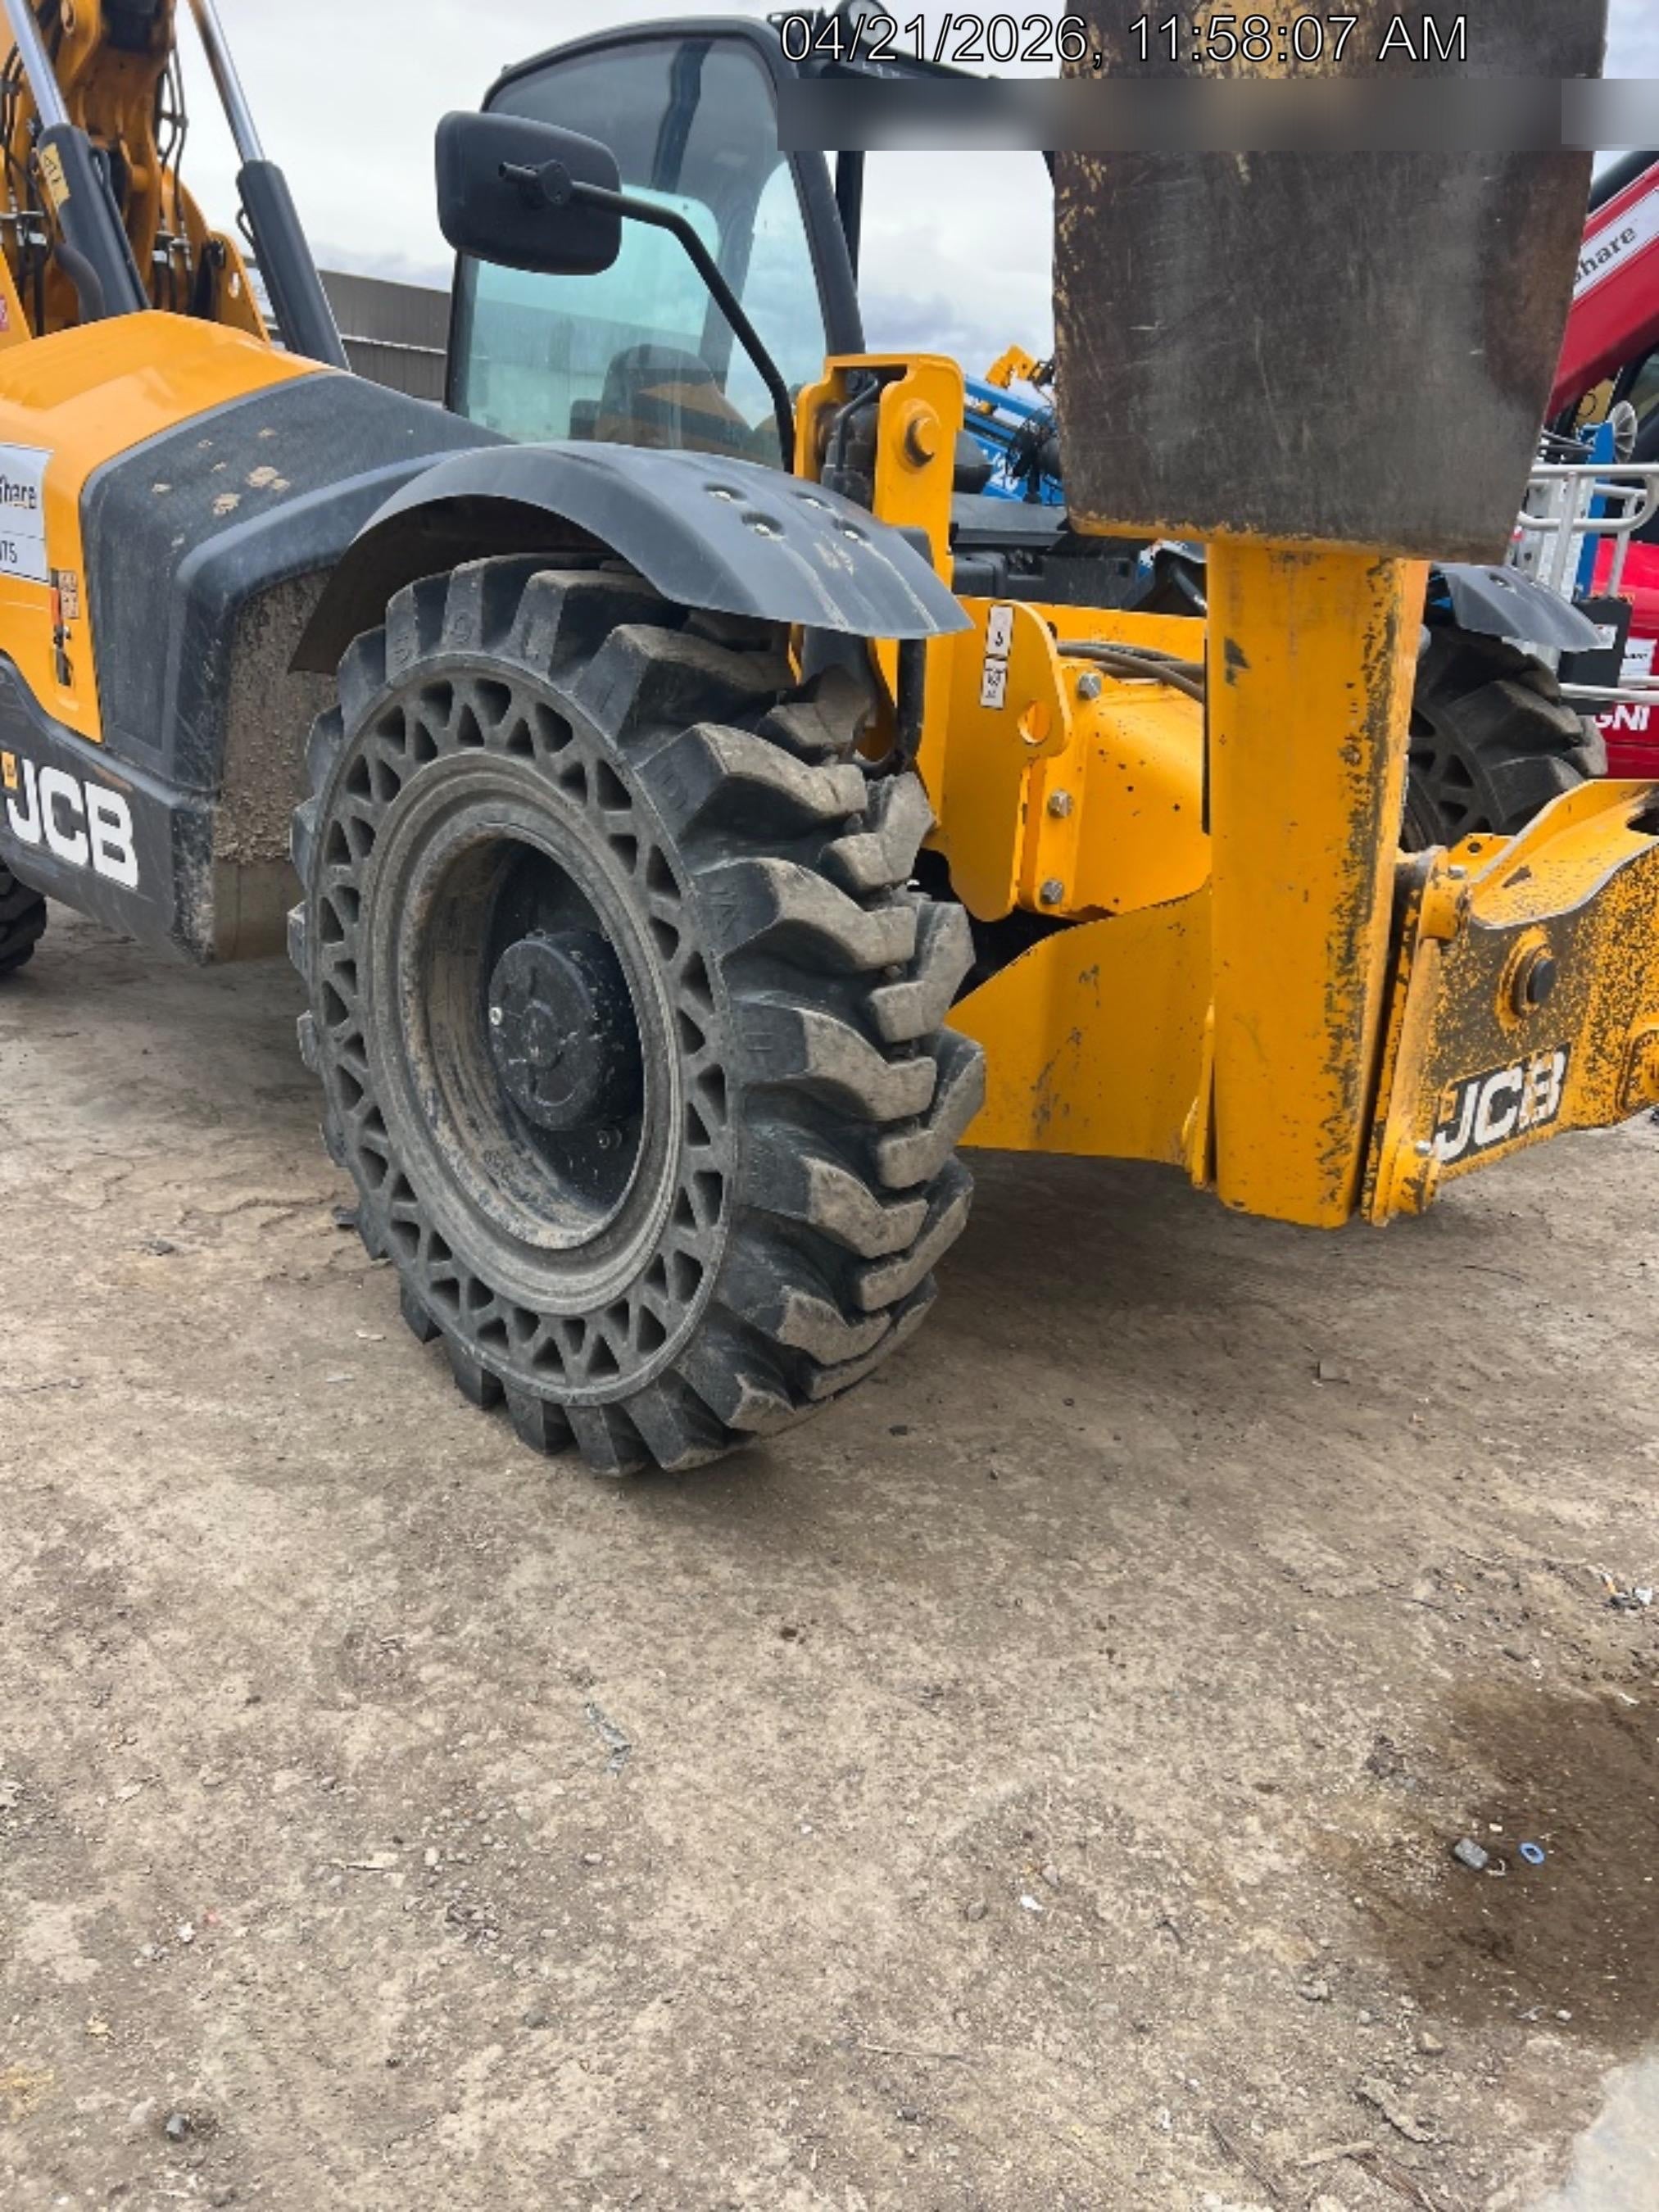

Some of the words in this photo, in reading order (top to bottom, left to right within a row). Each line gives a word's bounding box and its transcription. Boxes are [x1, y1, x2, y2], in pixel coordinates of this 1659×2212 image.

[0, 474, 37, 510] hare
[7, 759, 138, 888] JCB
[1434, 1051, 1566, 1163] JCB
